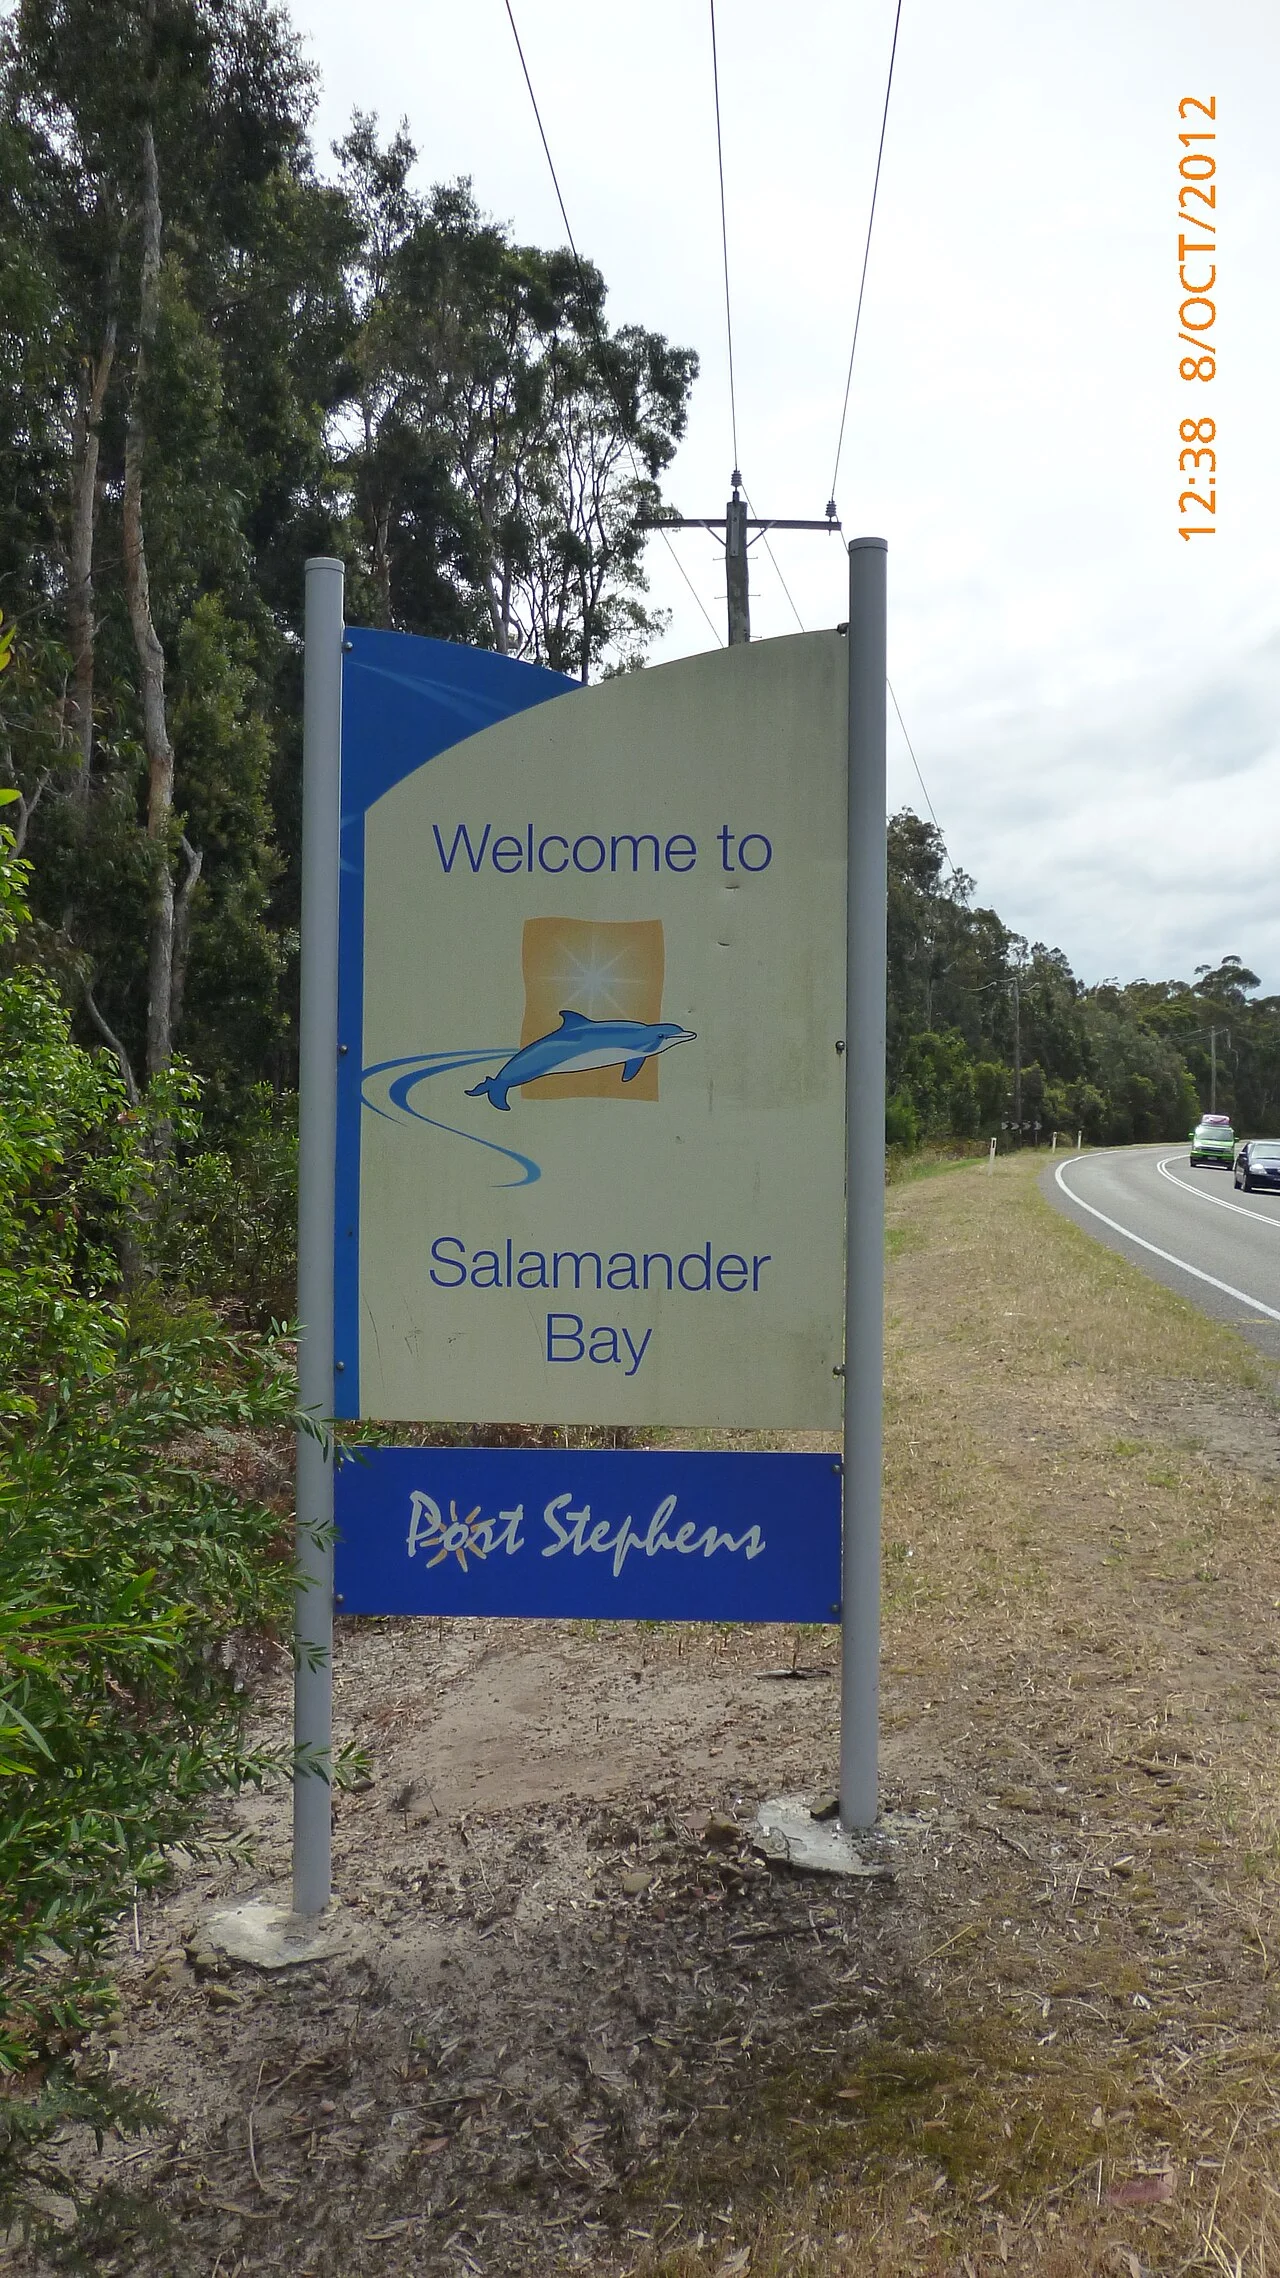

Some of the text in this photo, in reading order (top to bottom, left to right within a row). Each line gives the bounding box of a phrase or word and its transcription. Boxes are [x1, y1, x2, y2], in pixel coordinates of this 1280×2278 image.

[433, 823, 773, 874] Welcome to
[429, 1236, 771, 1292] Salamander
[546, 1313, 652, 1376] Bay
[406, 1489, 766, 1577] Port Stephens
